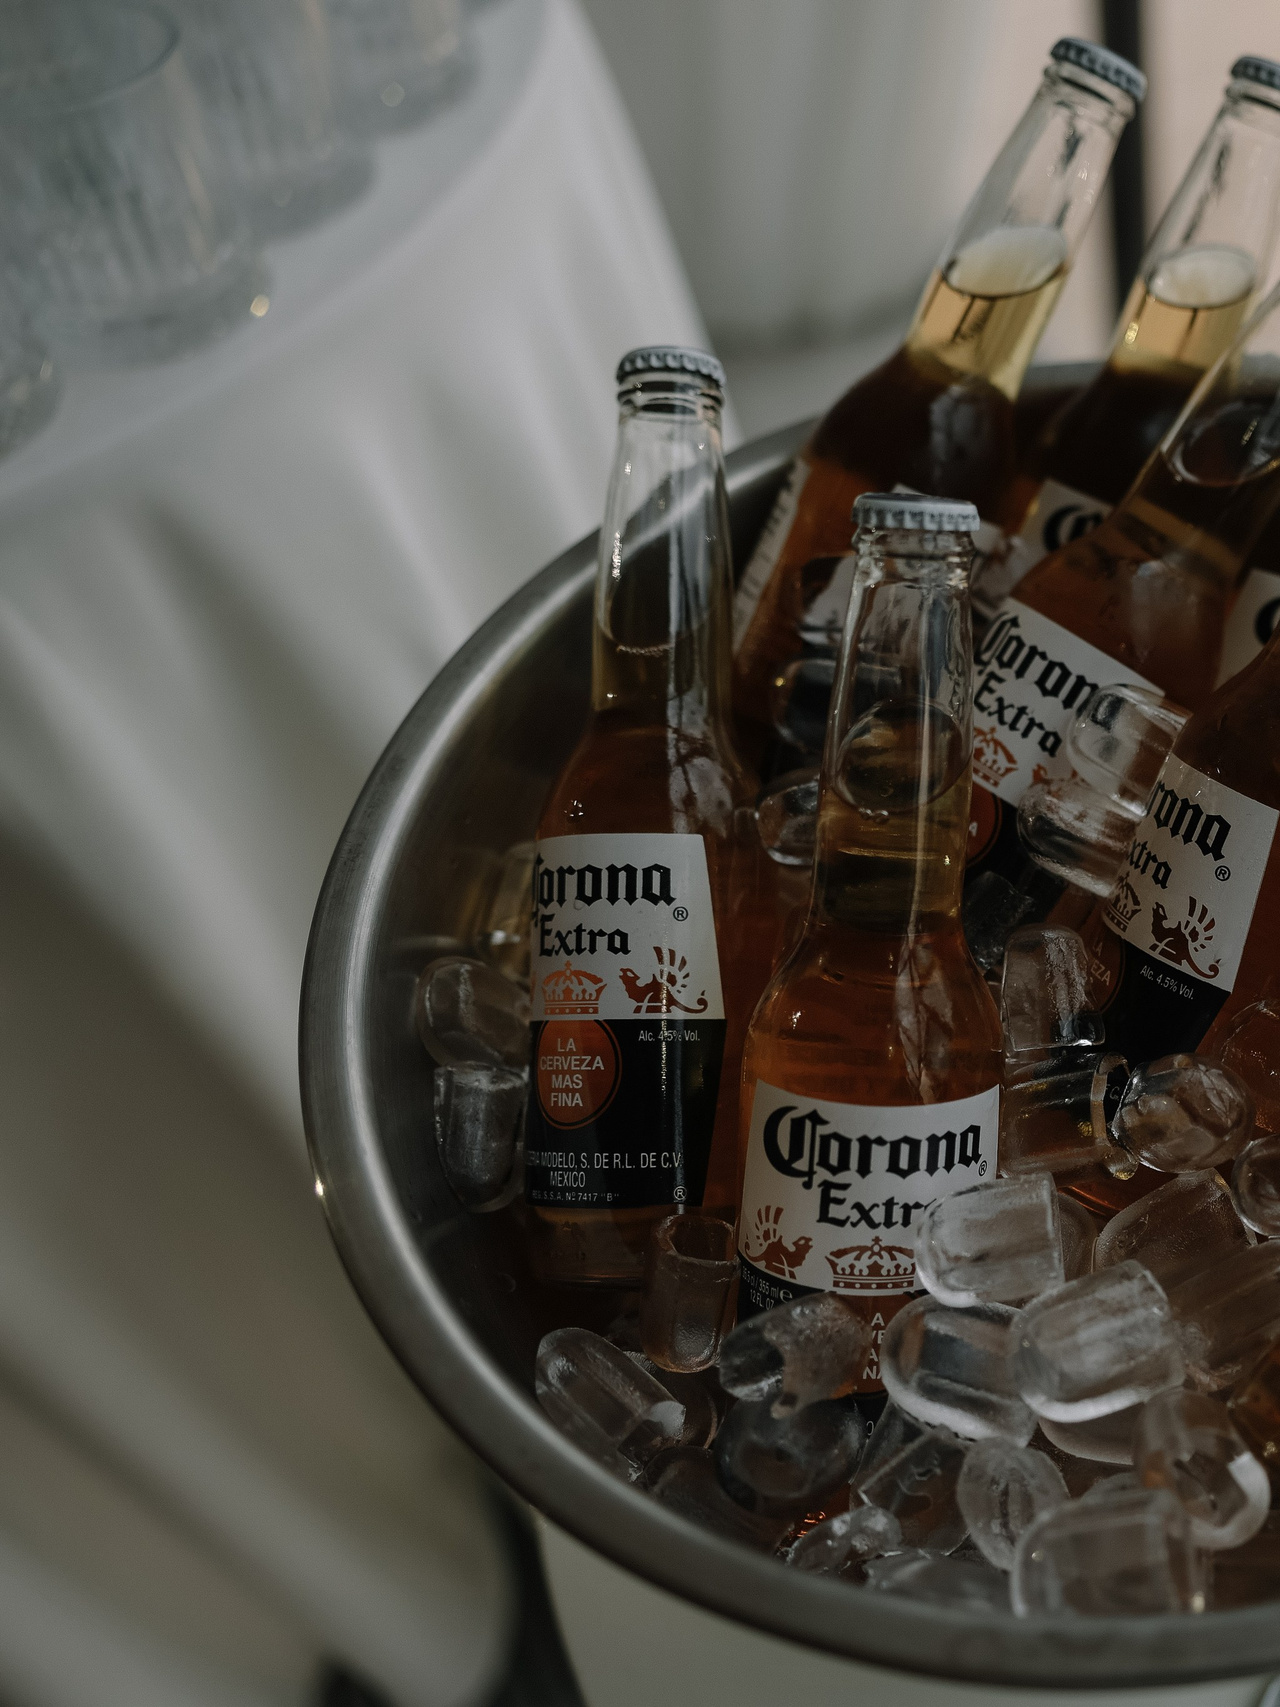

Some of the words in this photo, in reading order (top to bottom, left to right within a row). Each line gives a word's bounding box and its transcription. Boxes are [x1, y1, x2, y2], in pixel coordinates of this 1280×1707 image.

[974, 670, 1062, 758] Extra
[1127, 839, 1172, 890] xtra
[539, 913, 632, 957] Extra
[1140, 965, 1154, 981] Alc.
[1156, 974, 1178, 993] 4.5%
[1180, 983, 1194, 1000] Vol.
[638, 1030, 656, 1042] Alc.
[684, 1029, 701, 1041] Vol.
[557, 1038, 577, 1052] LA
[540, 1055, 605, 1071] CERVEZA
[551, 1074, 583, 1089] MAS
[550, 1092, 584, 1107] FINA
[762, 1105, 982, 1190] Corona
[580, 1152, 590, 1169] S.
[594, 1152, 609, 1169] DE
[613, 1152, 636, 1169] R.L.
[640, 1152, 658, 1169] DE
[550, 1171, 586, 1188] MEXICO
[816, 1179, 937, 1230] Extr
